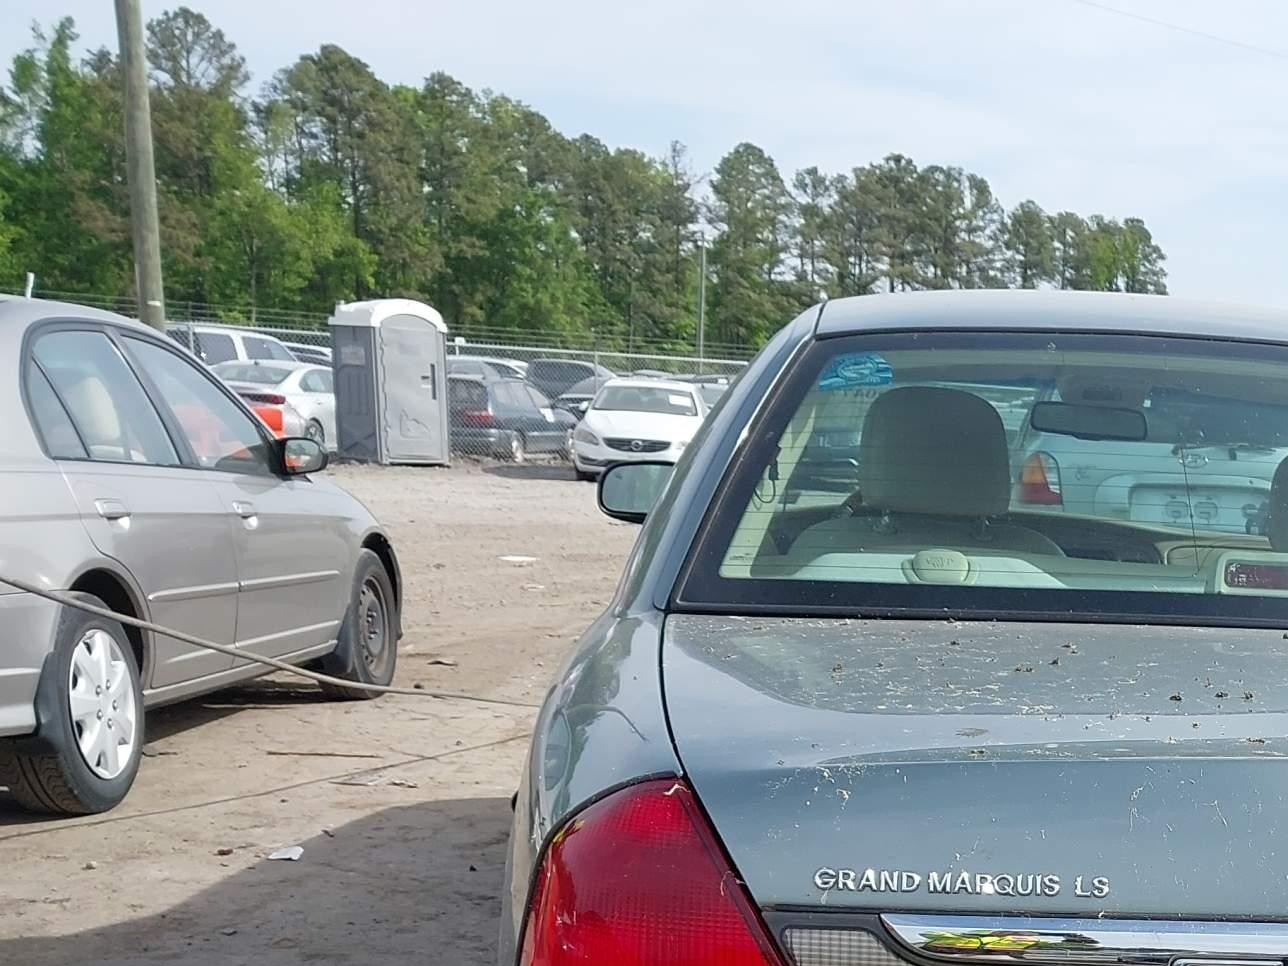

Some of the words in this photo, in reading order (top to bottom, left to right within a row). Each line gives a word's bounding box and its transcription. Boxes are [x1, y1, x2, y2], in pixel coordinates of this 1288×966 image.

[814, 868, 922, 893] GRAND
[927, 870, 1061, 897] MARQUIS
[1074, 875, 1111, 898] LS
